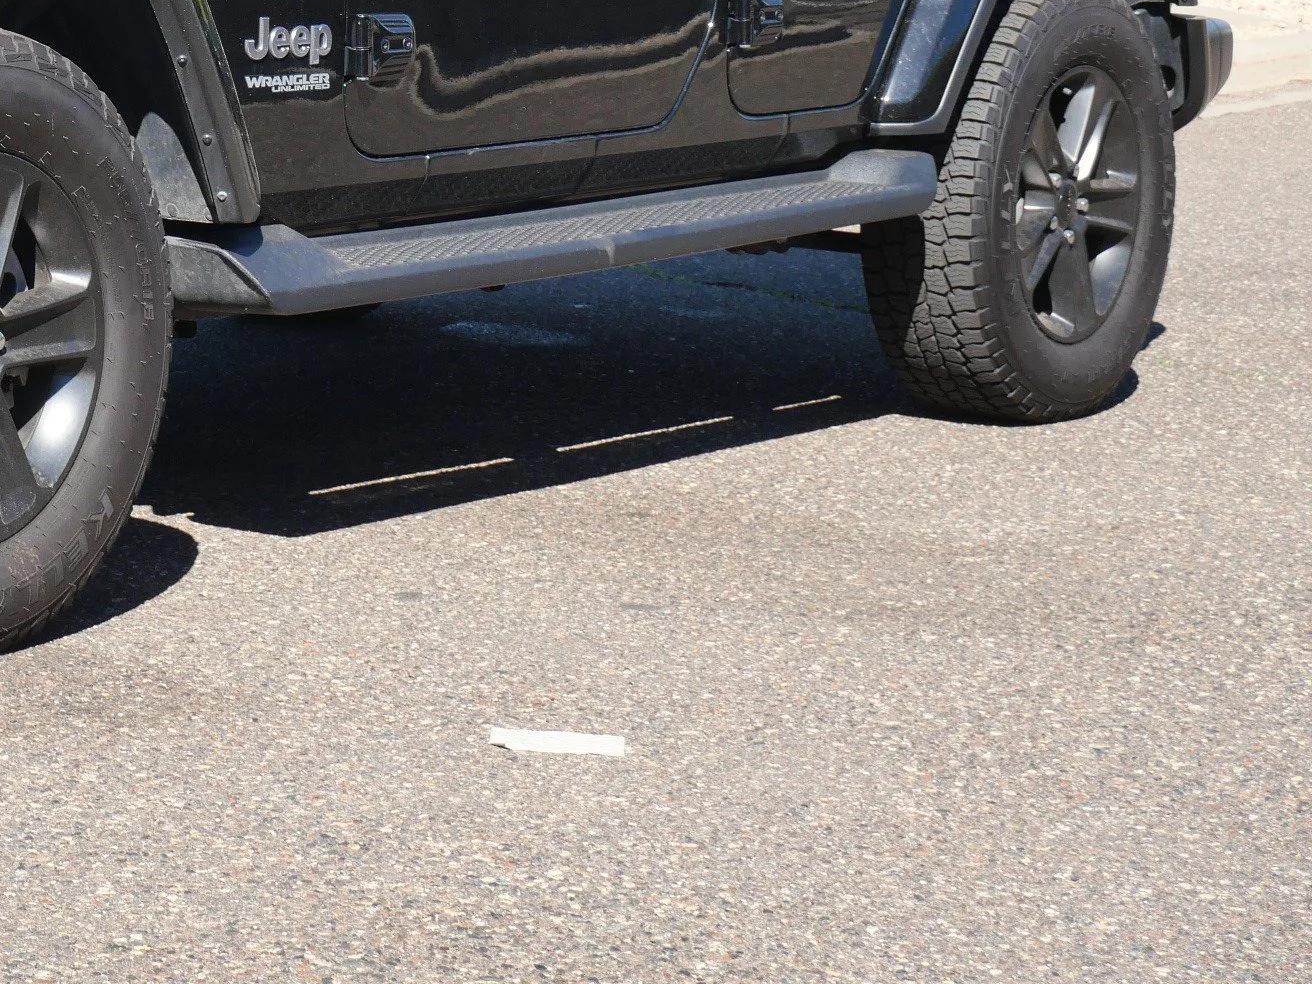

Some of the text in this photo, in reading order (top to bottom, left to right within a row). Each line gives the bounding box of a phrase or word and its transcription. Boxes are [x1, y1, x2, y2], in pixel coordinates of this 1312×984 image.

[244, 16, 333, 65] Jeep
[244, 72, 330, 89] WRANGLER
[271, 83, 331, 93] UNLIMITED
